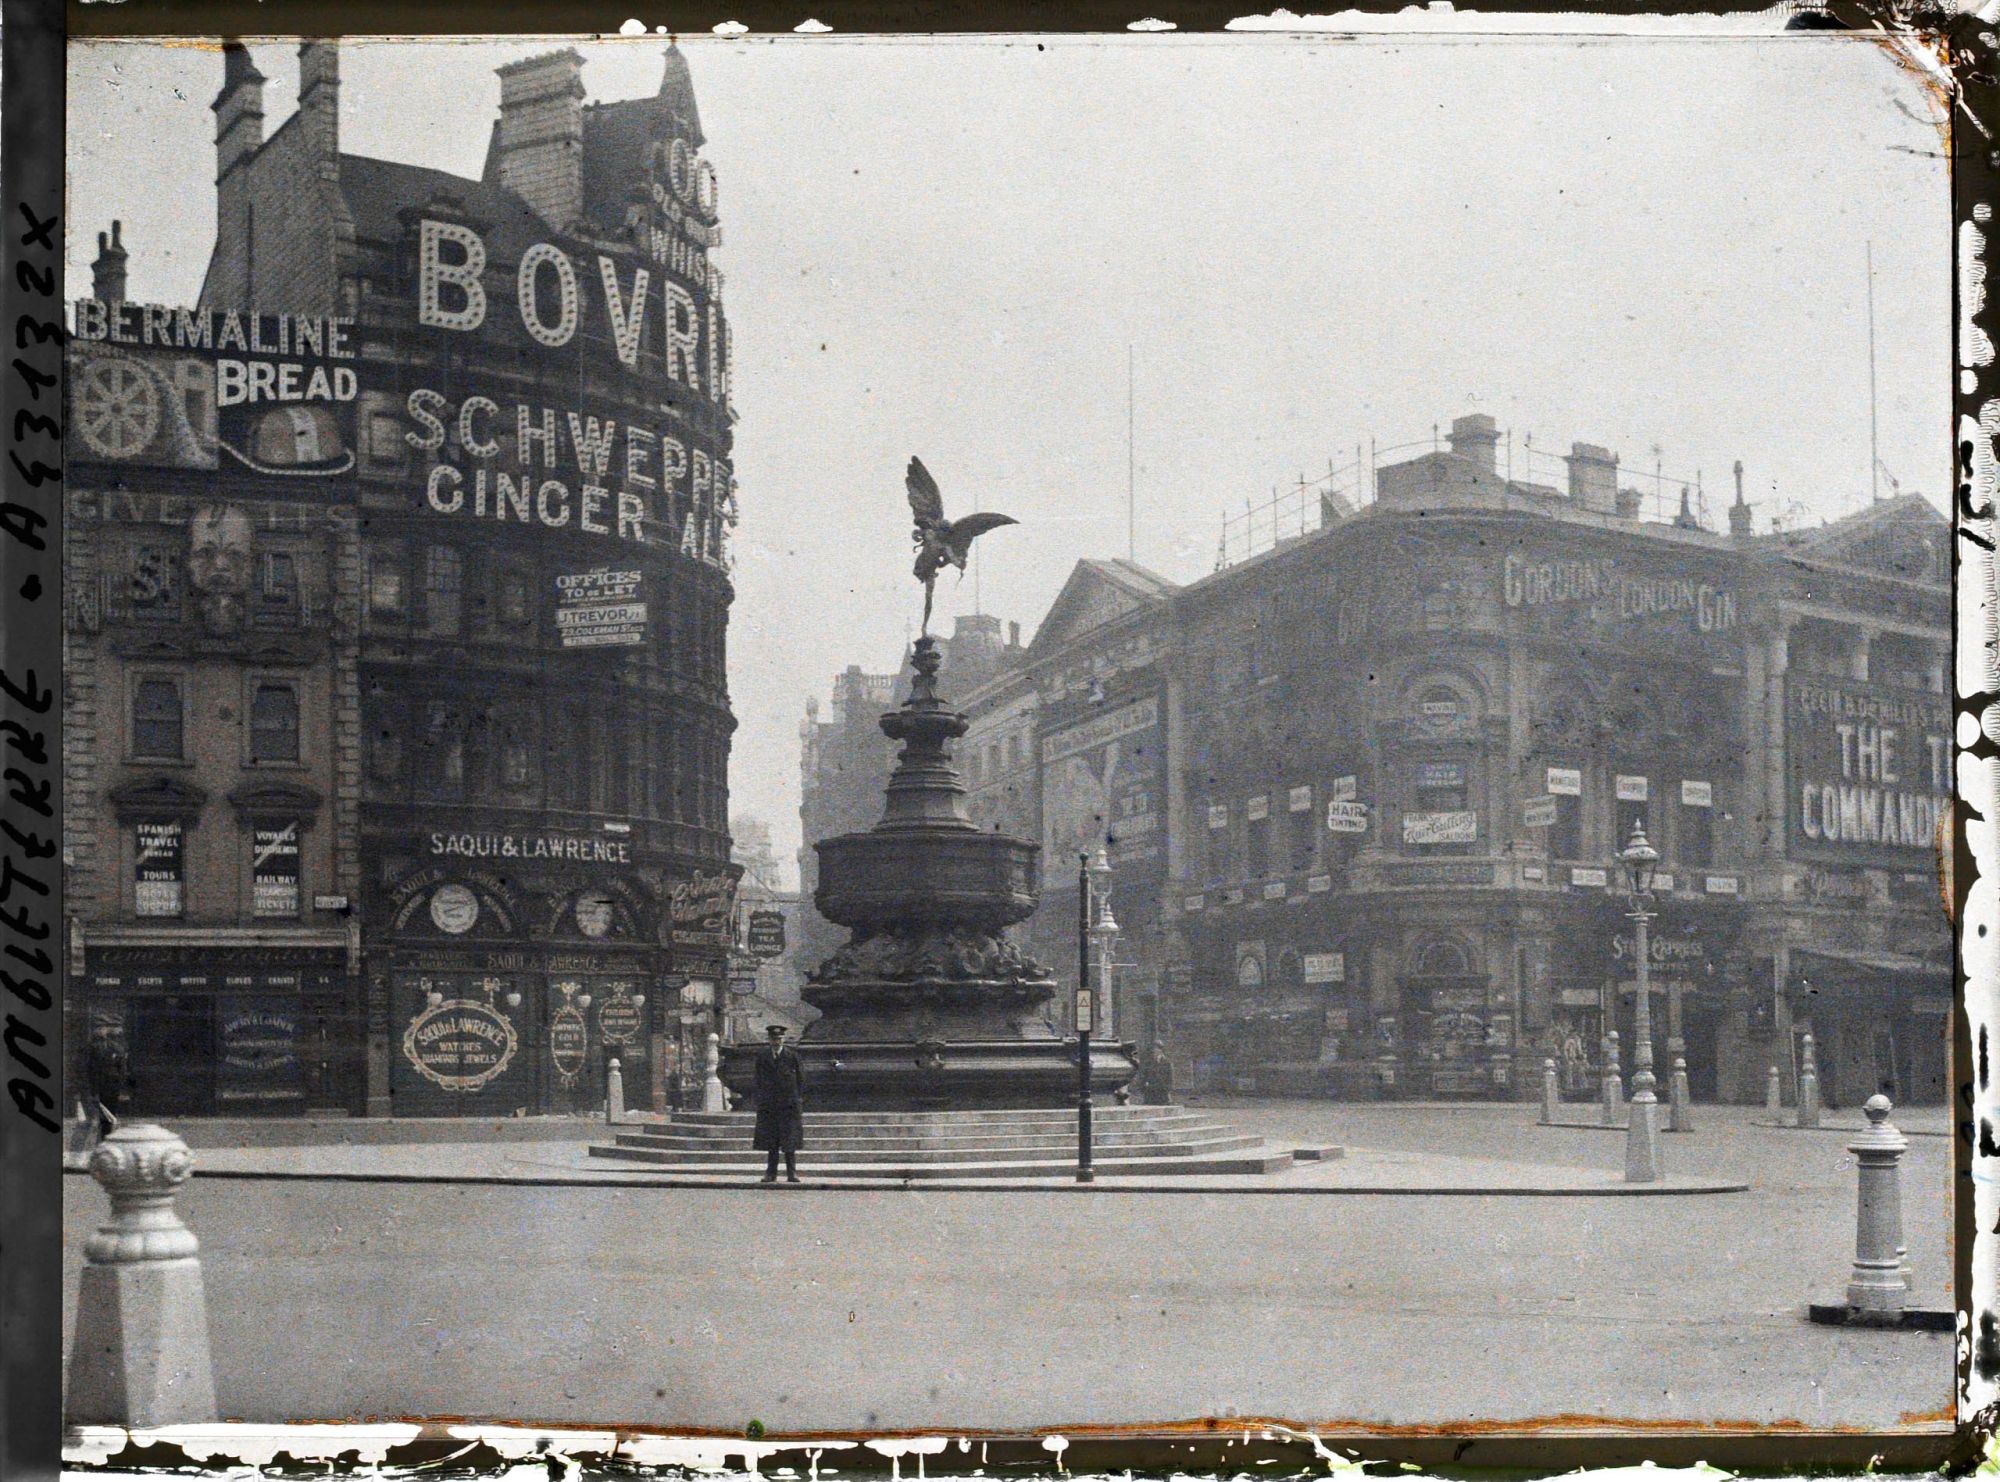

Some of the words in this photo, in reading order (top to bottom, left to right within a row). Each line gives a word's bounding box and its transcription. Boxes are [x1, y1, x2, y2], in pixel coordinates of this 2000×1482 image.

[76, 297, 356, 359] BERMALINE
[419, 219, 741, 424] BOVRIL
[217, 358, 358, 407] BREAD
[427, 465, 645, 543] GINGER
[556, 570, 642, 589] OFFICES
[564, 588, 585, 598] TO
[604, 584, 636, 595] LET
[1619, 578, 1694, 619] LONDON
[1698, 584, 1737, 632] GIN
[570, 608, 628, 622] TREVOR
[1836, 723, 1900, 783] THE
[1331, 804, 1363, 817] HAIR
[137, 824, 182, 835] SPANISH
[1330, 818, 1365, 829] TINTING
[139, 836, 179, 847] TRAVEL
[431, 833, 498, 858] SAQUI
[522, 837, 631, 864] LAWRENCE
[143, 849, 173, 858] BUREAU
[143, 871, 175, 881] TOURS
[256, 874, 296, 884] RAILWAY
[750, 944, 782, 952] LOUNGE
[488, 953, 524, 970] SAQUI
[451, 1017, 507, 1047] LAWRENCE
[439, 1041, 482, 1052] WATHES
[464, 1053, 498, 1065] JEWELS
